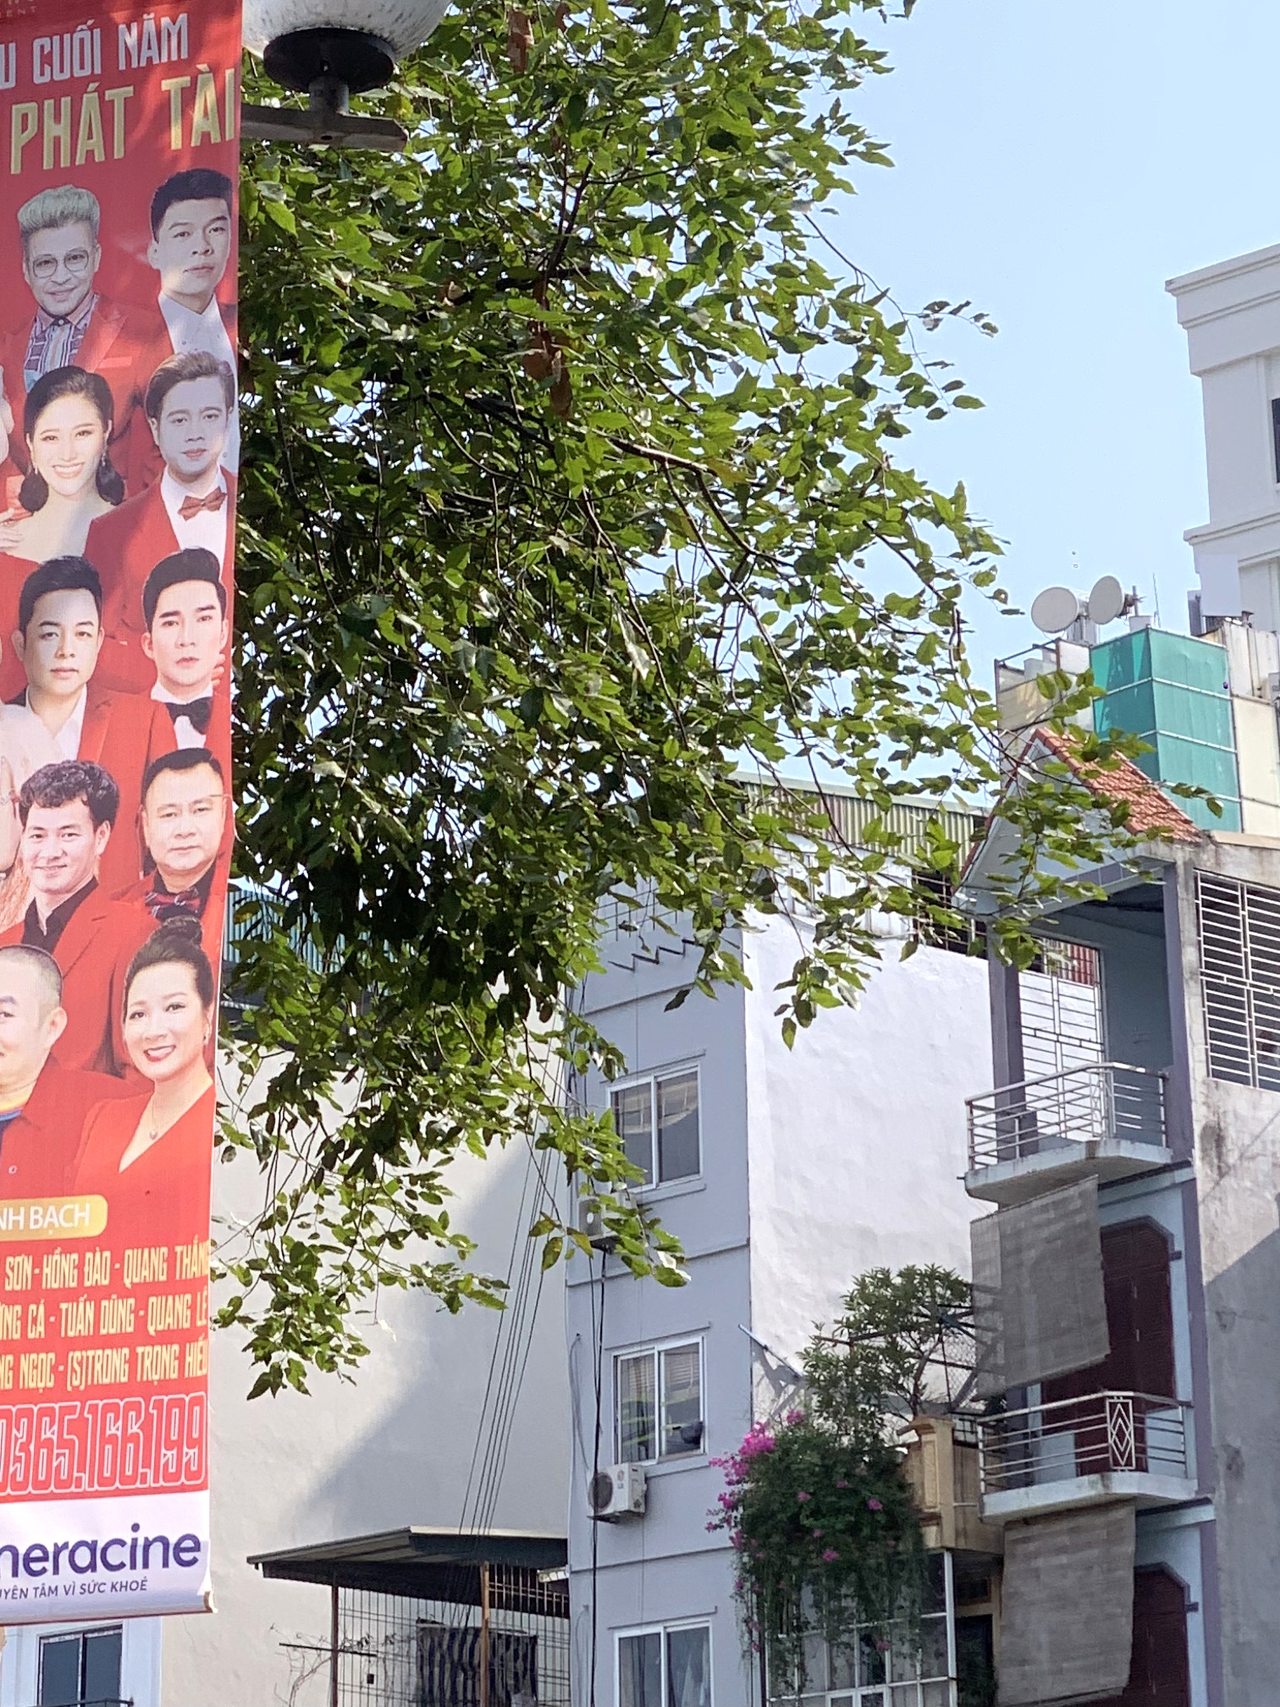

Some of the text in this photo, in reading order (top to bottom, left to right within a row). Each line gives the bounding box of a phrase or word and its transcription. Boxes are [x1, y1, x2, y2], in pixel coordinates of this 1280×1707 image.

[32, 17, 102, 84] CUỐI
[119, 12, 188, 71] NĂM
[10, 81, 134, 175] PHÁT
[162, 63, 235, 151] TÀI
[28, 1203, 91, 1235] BẠCH
[5, 1254, 32, 1291] SƠN
[84, 1247, 111, 1287] ĐÀO
[123, 1247, 168, 1288] QUANG
[27, 1299, 46, 1339] CÁ
[59, 1294, 95, 1338] TUẤN
[99, 1294, 136, 1336] DŨNG
[147, 1293, 192, 1336] QUANG
[19, 1352, 56, 1394] NGỌC
[136, 1344, 180, 1386] TRỌNG
[33, 1582, 59, 1599] TÂM
[63, 1581, 76, 1596] VÌ
[79, 1579, 107, 1595] SỨC
